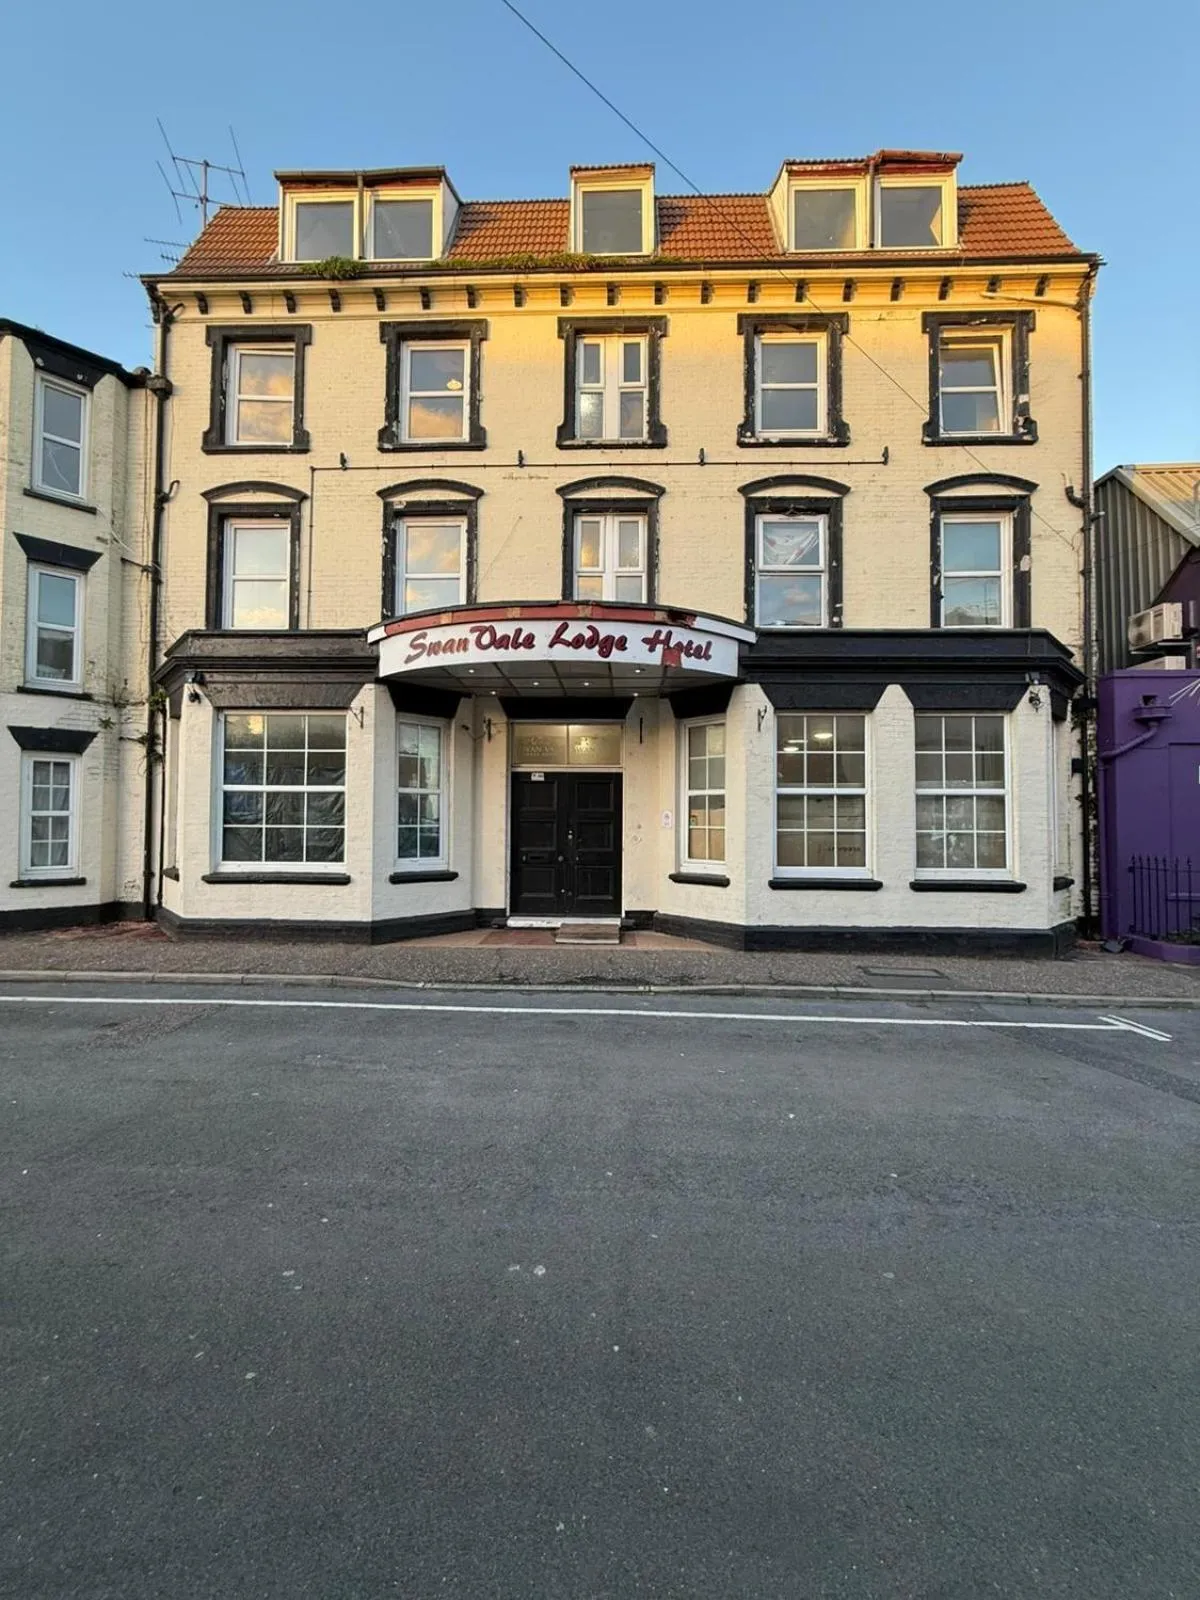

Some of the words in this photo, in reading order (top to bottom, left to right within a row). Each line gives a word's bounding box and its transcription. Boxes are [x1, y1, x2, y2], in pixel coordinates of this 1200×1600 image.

[404, 631, 469, 664] Swan
[470, 624, 536, 651] Vale
[548, 621, 628, 659] Lodge
